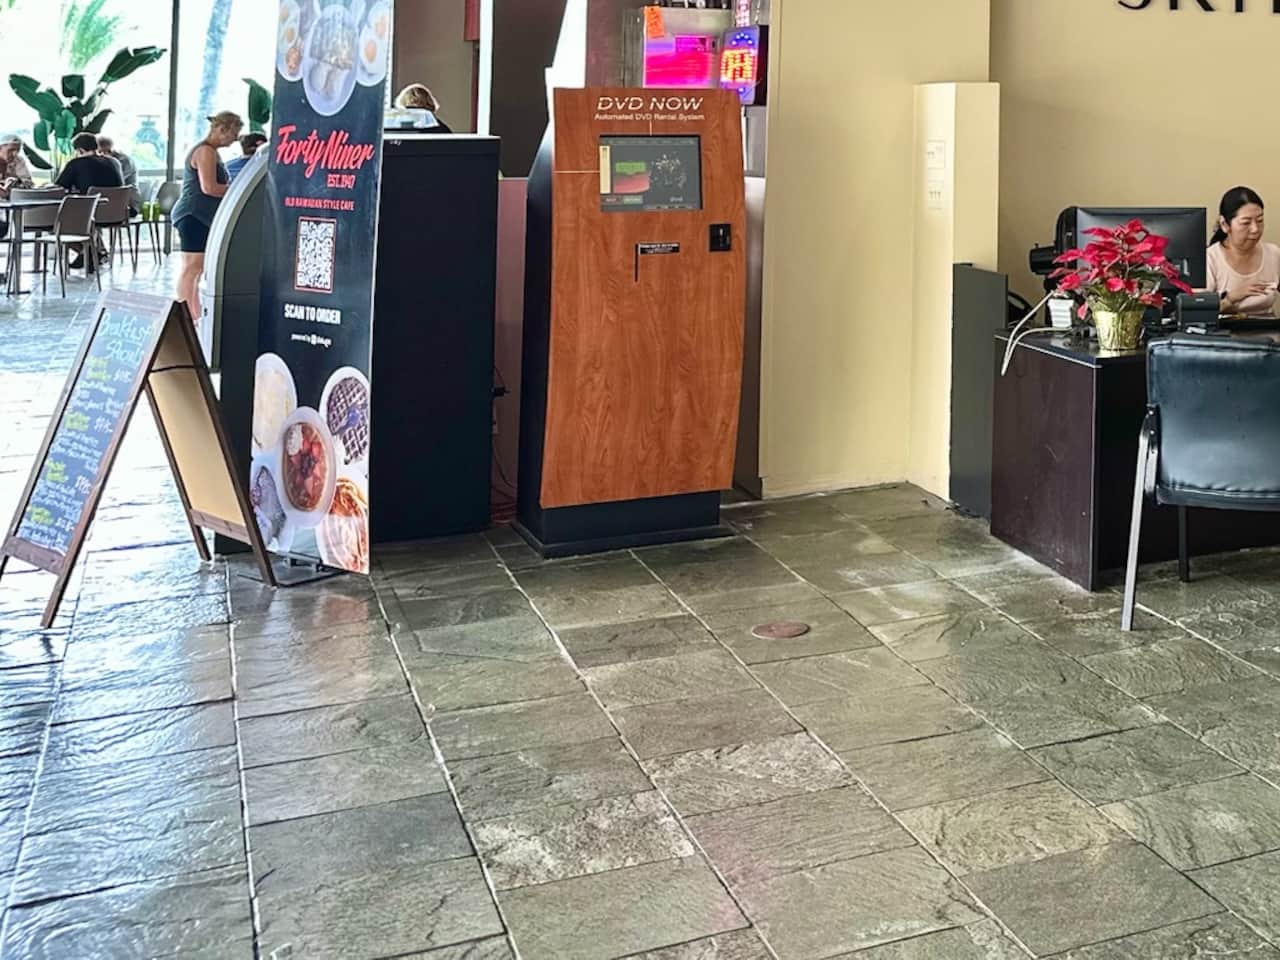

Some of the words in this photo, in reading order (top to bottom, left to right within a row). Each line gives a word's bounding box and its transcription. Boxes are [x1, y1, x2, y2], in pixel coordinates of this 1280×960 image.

[597, 96, 644, 111] DVD
[649, 96, 704, 111] NOW
[594, 113, 634, 121] Automated
[635, 113, 653, 121] DVD
[654, 113, 677, 121] Rental
[678, 113, 705, 122] System
[276, 125, 325, 178] Forty
[320, 129, 375, 170] Niner
[323, 199, 340, 210] STYLE
[284, 303, 305, 320] SCAN
[305, 306, 316, 321] TO
[316, 307, 341, 325] ORDER
